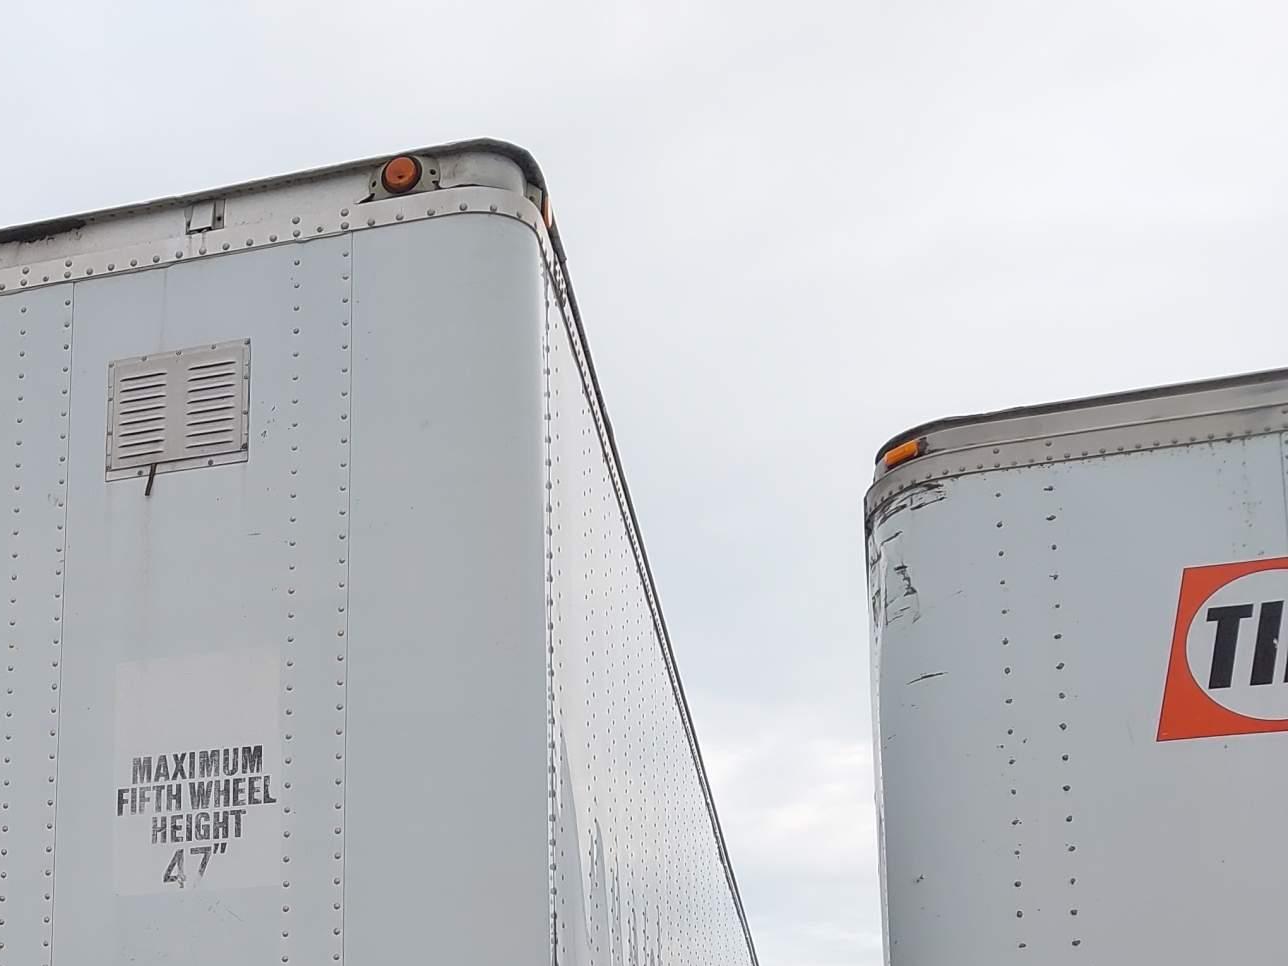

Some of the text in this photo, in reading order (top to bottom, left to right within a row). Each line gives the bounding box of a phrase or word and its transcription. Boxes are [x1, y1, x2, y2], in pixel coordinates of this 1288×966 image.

[1206, 600, 1288, 690] TI
[132, 745, 263, 784] MAXIMUM
[117, 775, 277, 816] FIFTH WHEEL
[152, 809, 246, 844] HEIGHT
